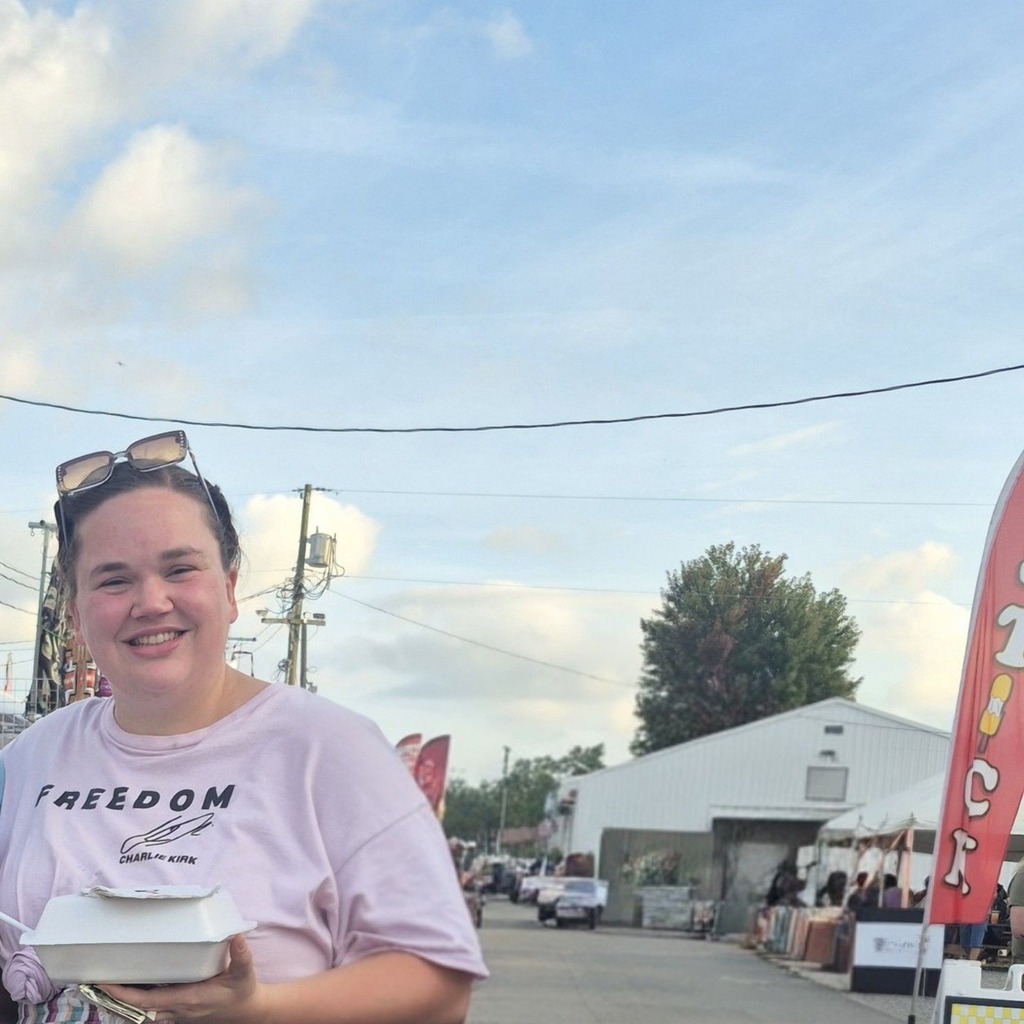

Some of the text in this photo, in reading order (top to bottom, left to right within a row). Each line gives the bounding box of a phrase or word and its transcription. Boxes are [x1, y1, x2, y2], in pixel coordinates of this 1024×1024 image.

[35, 784, 236, 812] FREEDOM
[119, 852, 199, 865] CHARLIE KIRK
